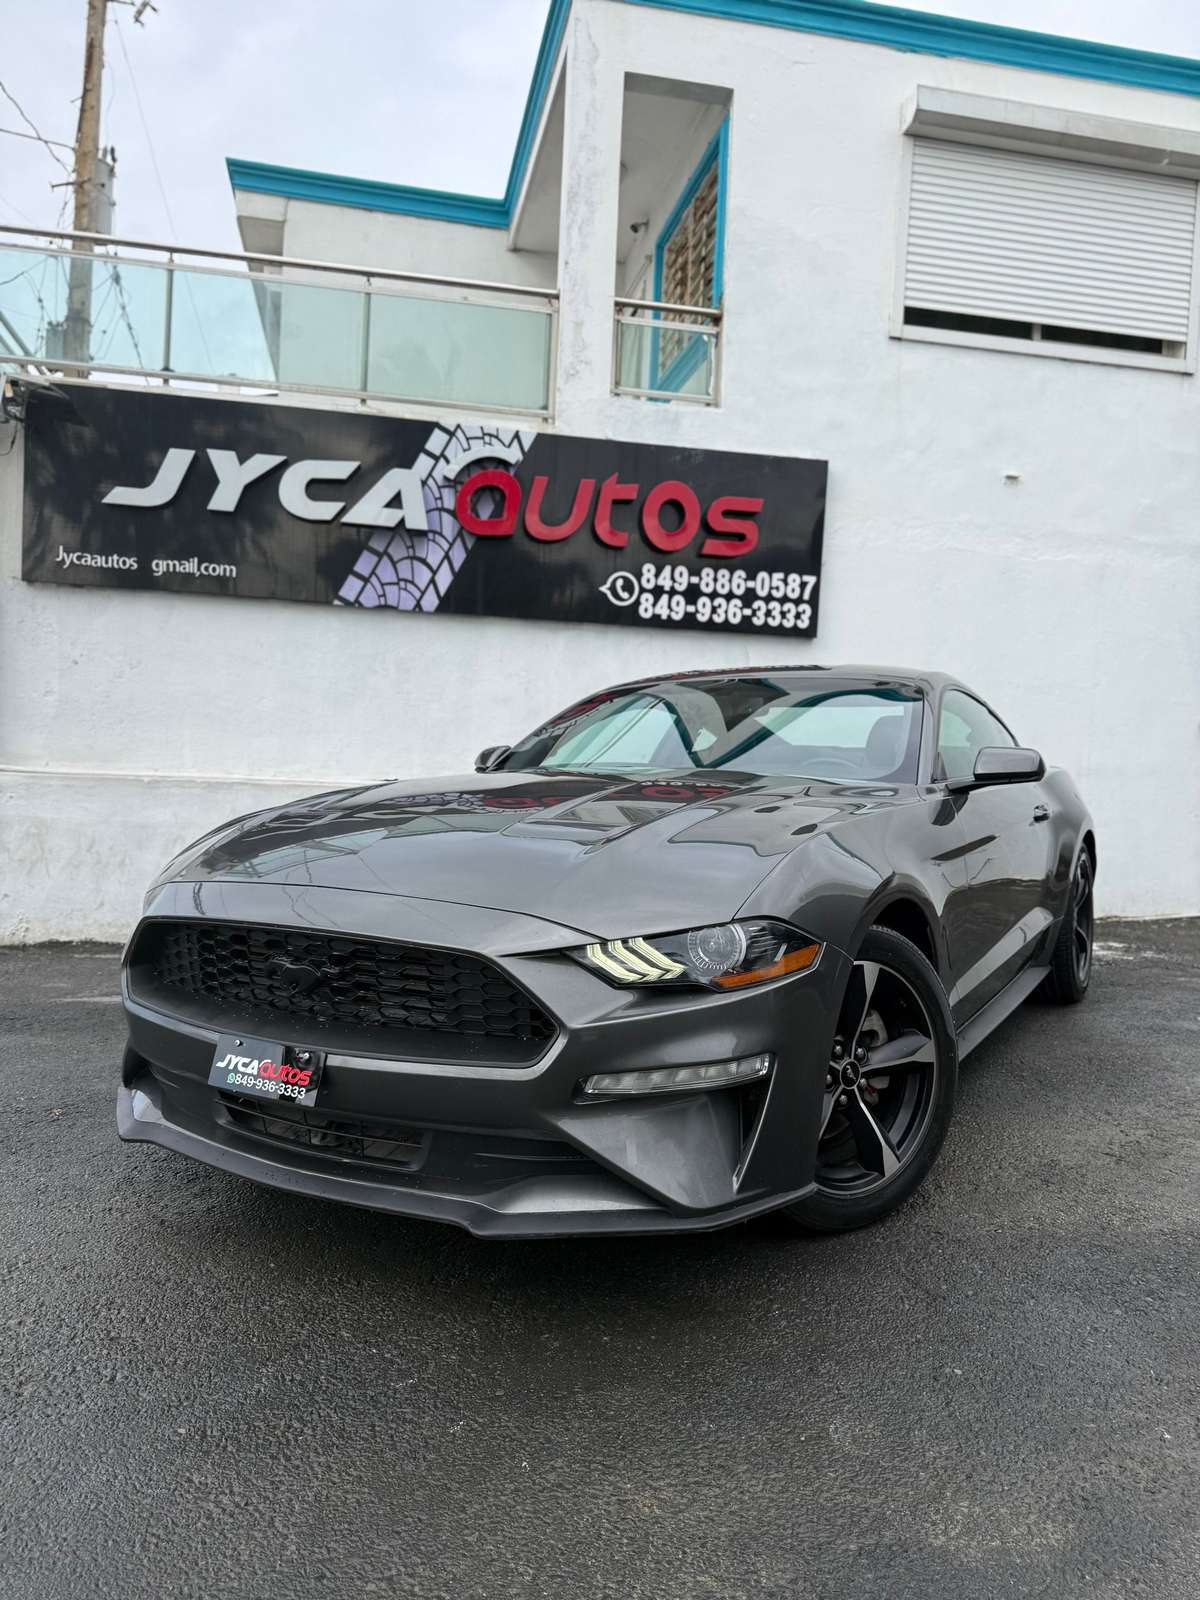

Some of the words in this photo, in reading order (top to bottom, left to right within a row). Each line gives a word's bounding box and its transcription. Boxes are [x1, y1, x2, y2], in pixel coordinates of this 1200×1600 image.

[55, 545, 138, 571] Jycaautos
[640, 563, 817, 601] 849-886-0587
[638, 593, 812, 630] 849-936-3333
[234, 1073, 306, 1099] 849-936-3333
